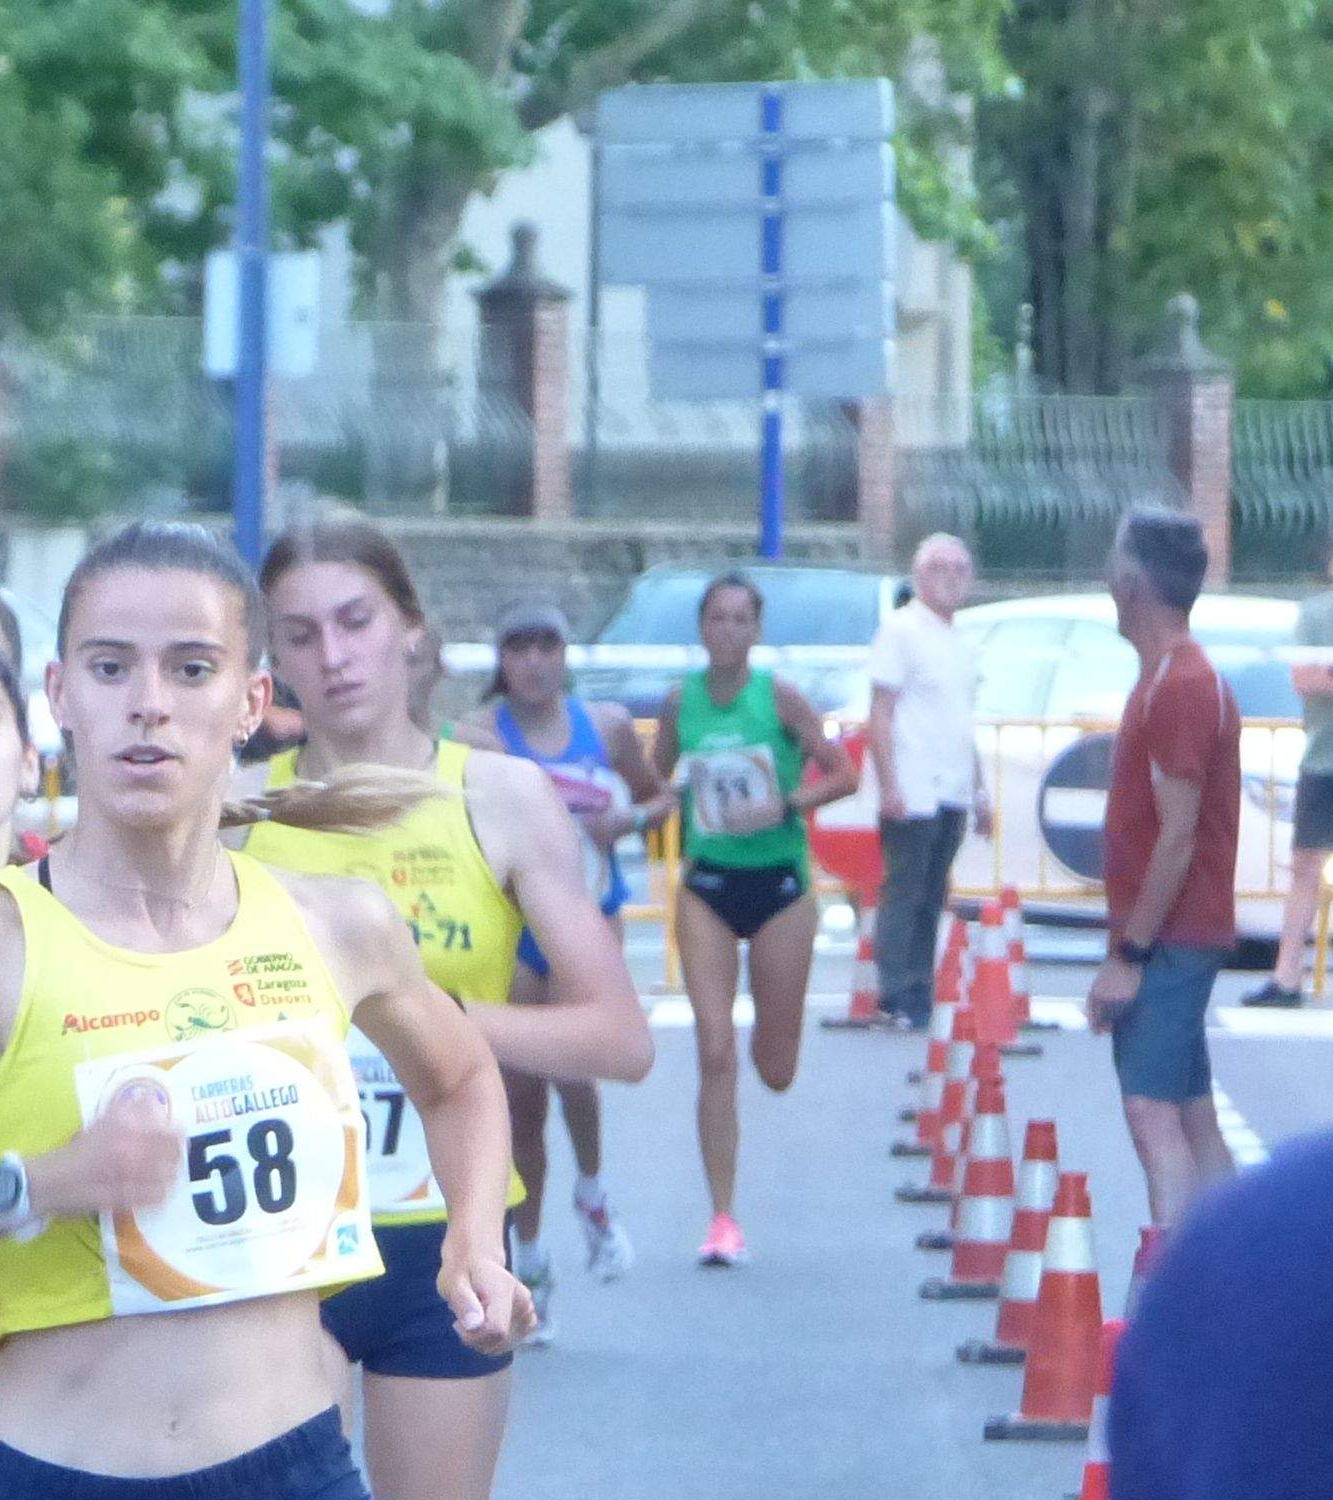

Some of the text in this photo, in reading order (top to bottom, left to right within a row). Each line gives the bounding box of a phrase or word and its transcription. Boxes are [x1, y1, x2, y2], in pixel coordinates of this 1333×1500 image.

[257, 978, 308, 991] Zaragoza
[62, 1009, 161, 1036] Alcampo
[191, 1075, 254, 1101] CARRERAS
[187, 1118, 297, 1226] 58
